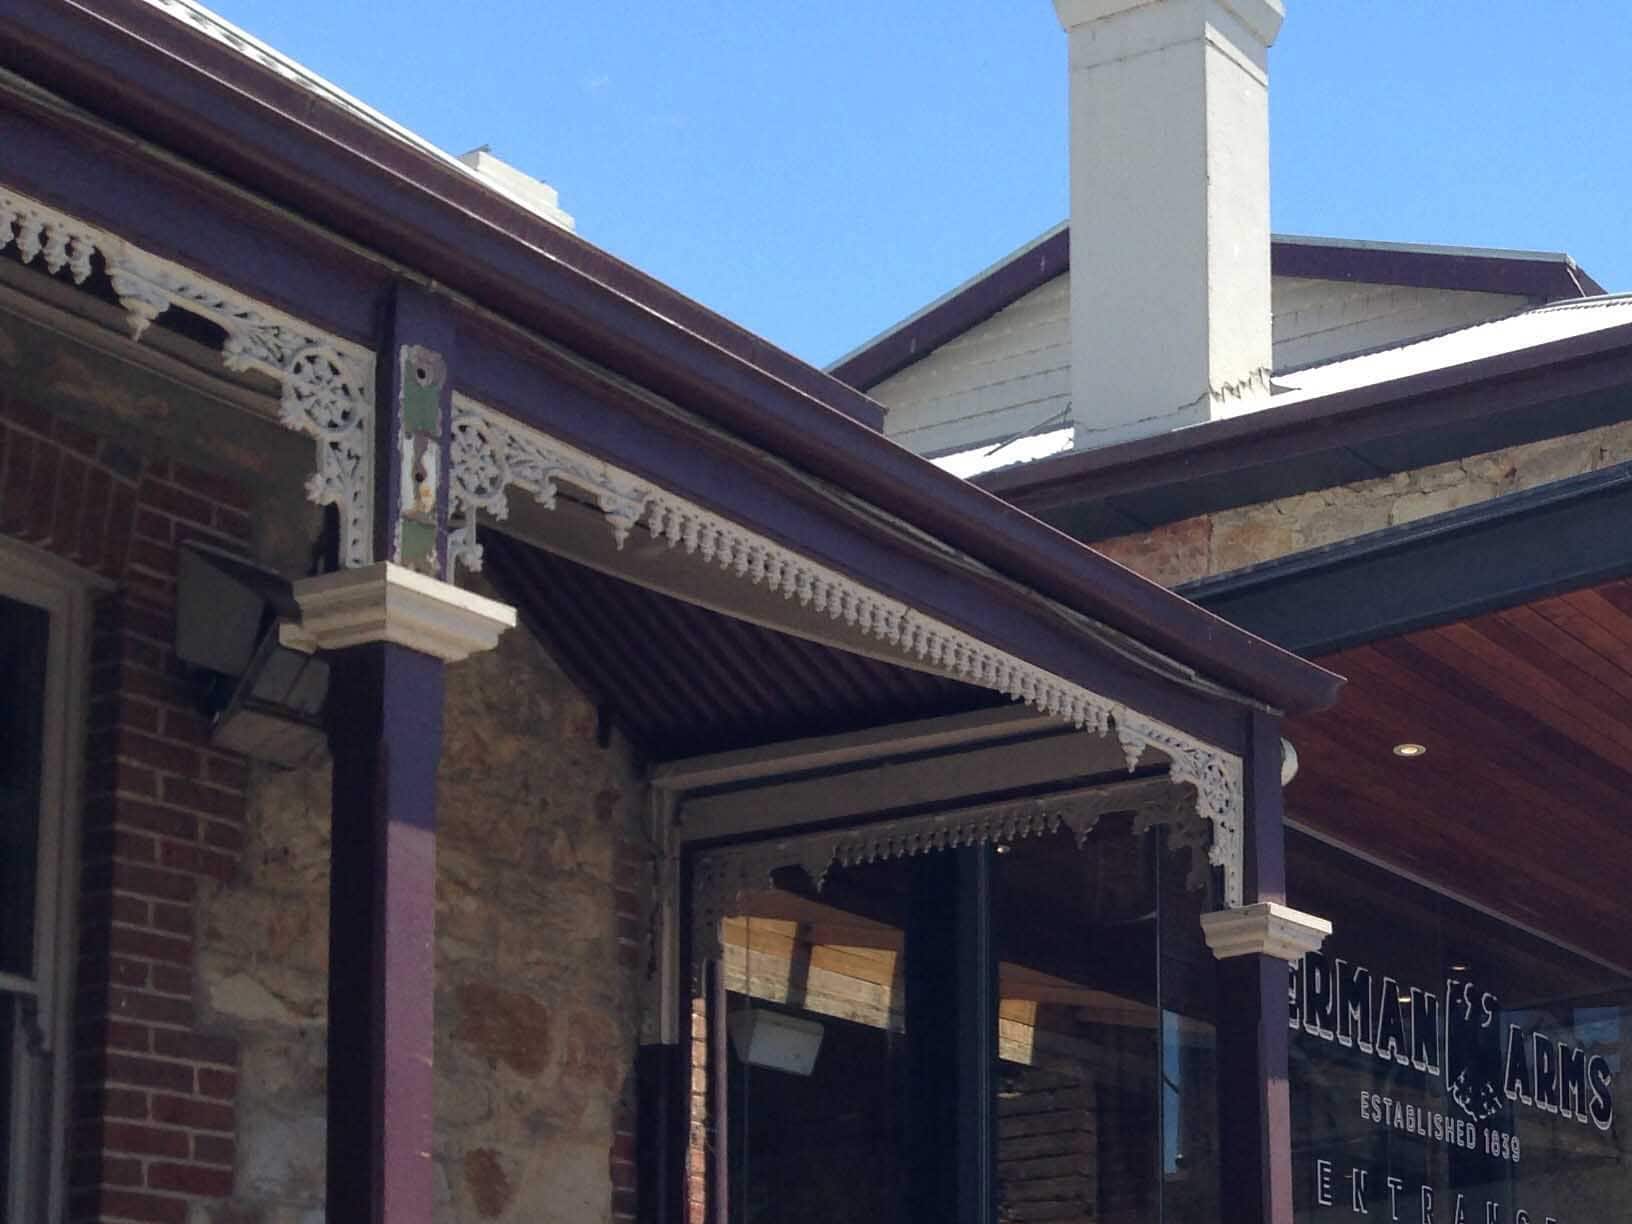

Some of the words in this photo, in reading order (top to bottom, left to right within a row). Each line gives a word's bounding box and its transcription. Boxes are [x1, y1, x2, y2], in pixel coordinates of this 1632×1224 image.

[1504, 1023, 1614, 1131] ARMS
[1360, 1090, 1477, 1150] ESTABLISHED
[1483, 1127, 1521, 1163] 1839
